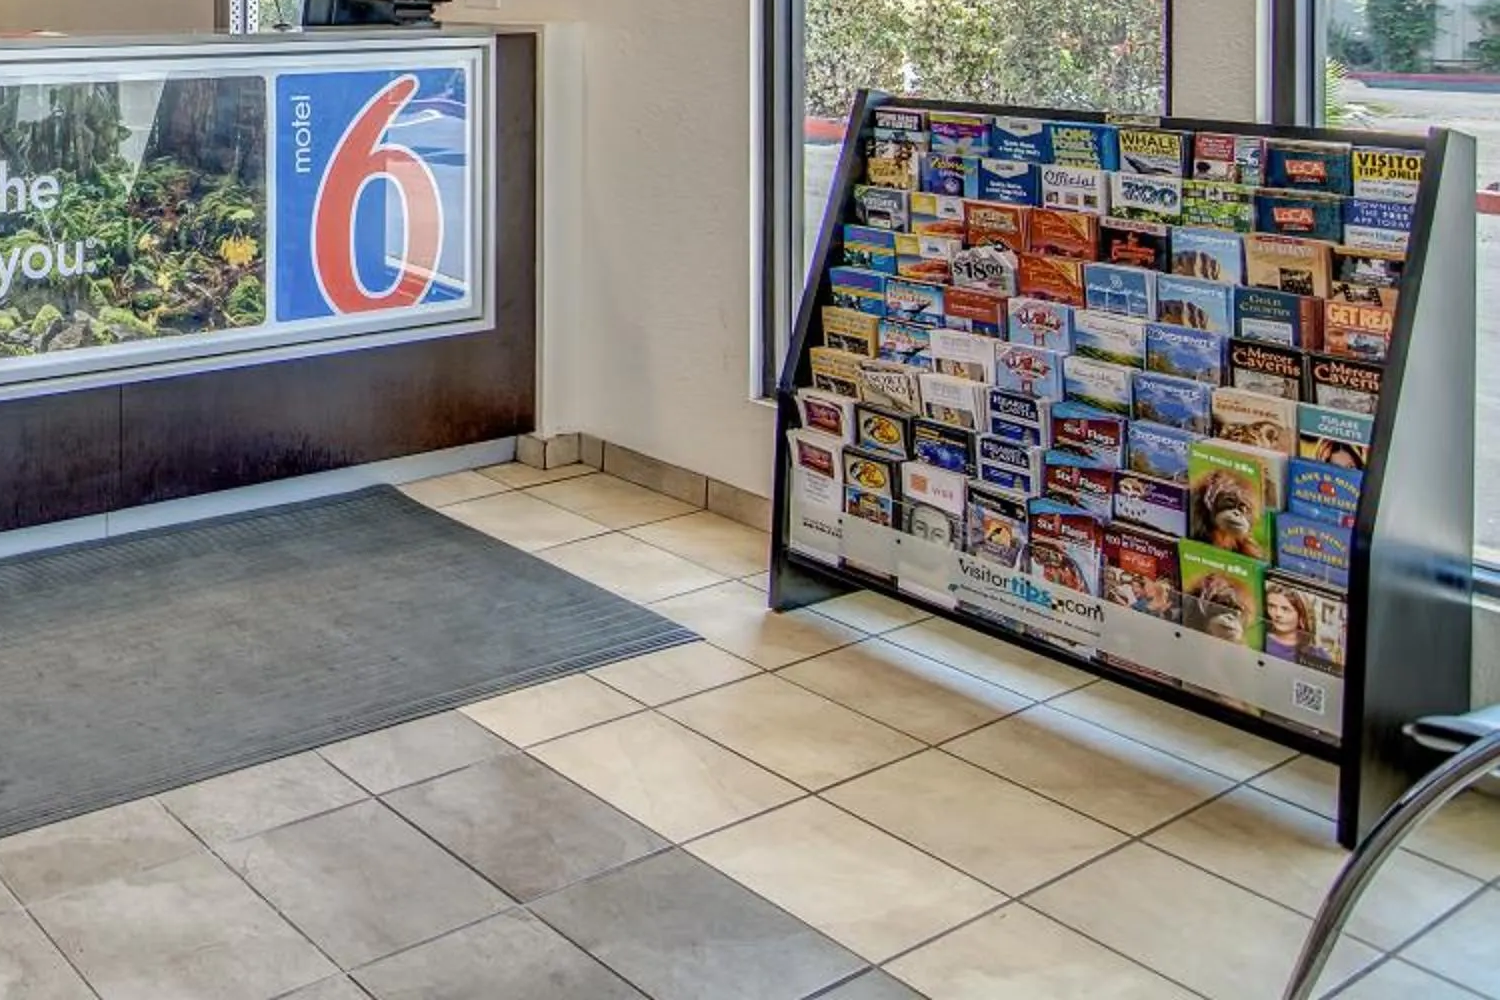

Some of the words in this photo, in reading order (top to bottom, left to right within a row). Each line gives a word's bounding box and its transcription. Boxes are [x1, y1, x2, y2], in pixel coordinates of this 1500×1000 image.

[291, 95, 311, 174] motel
[1121, 131, 1179, 150] WHALE
[1357, 153, 1421, 170] VISITO
[1358, 166, 1383, 178] TIPS
[310, 73, 445, 316] 6
[1327, 303, 1358, 325] GET
[1359, 307, 1393, 333] REA
[1232, 350, 1301, 377] Caverns
[1247, 346, 1294, 365] Mercer
[1314, 364, 1380, 391] Cavern
[1330, 361, 1381, 381] Mercer
[1062, 421, 1080, 435] Six
[1055, 468, 1073, 482] Six
[1036, 518, 1056, 532] Six
[1060, 523, 1090, 541] Flags
